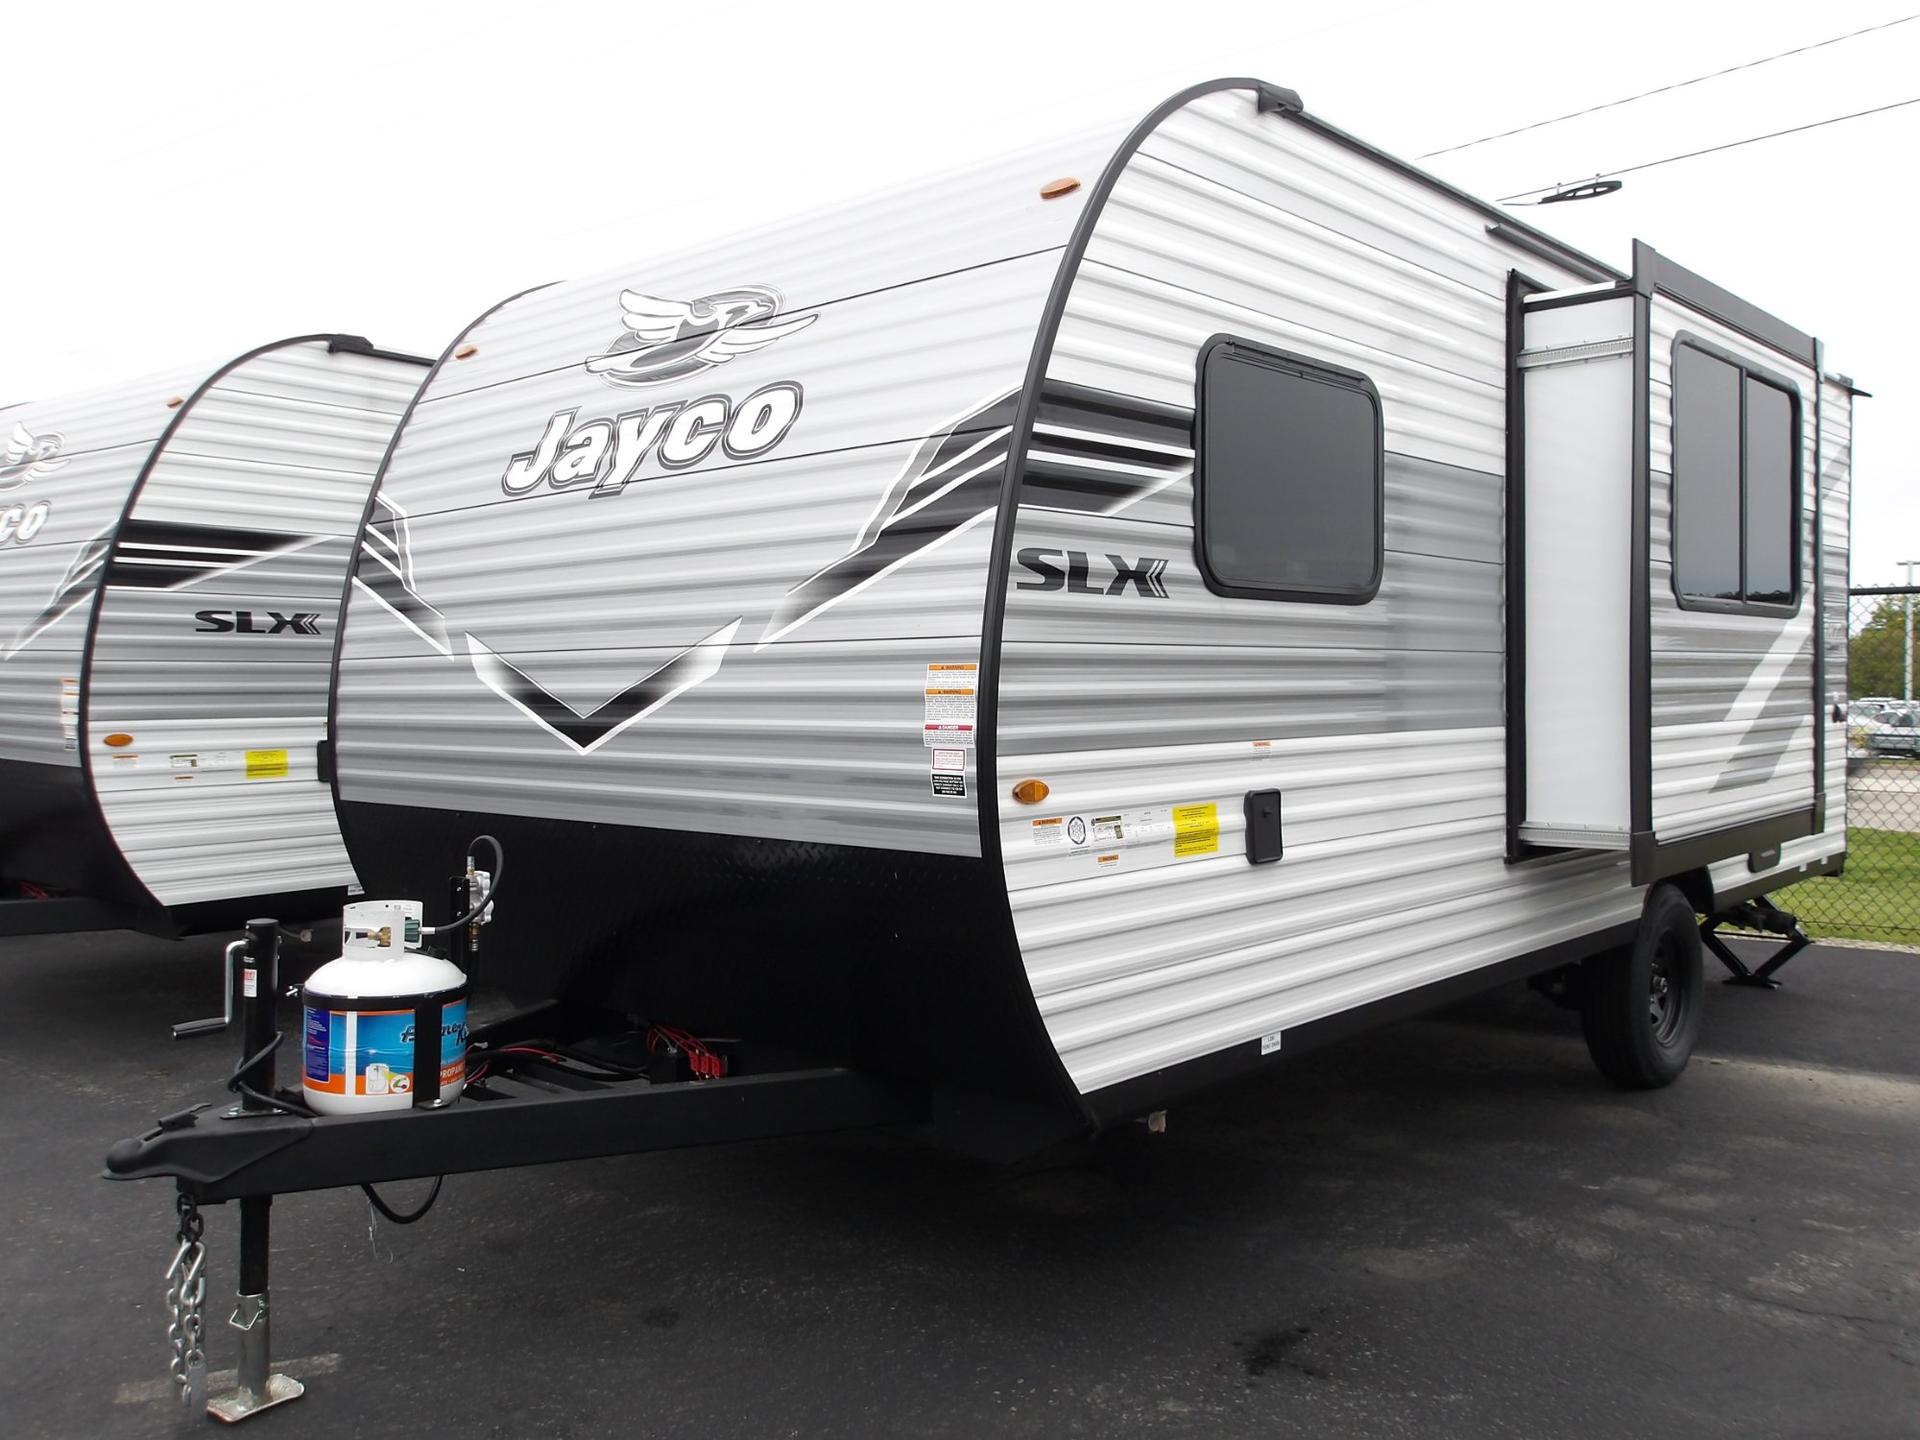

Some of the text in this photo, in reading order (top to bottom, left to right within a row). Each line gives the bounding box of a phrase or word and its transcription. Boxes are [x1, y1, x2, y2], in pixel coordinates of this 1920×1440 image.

[502, 380, 804, 500] Jayco
[1017, 547, 1170, 599] SLX
[195, 610, 321, 635] SLX
